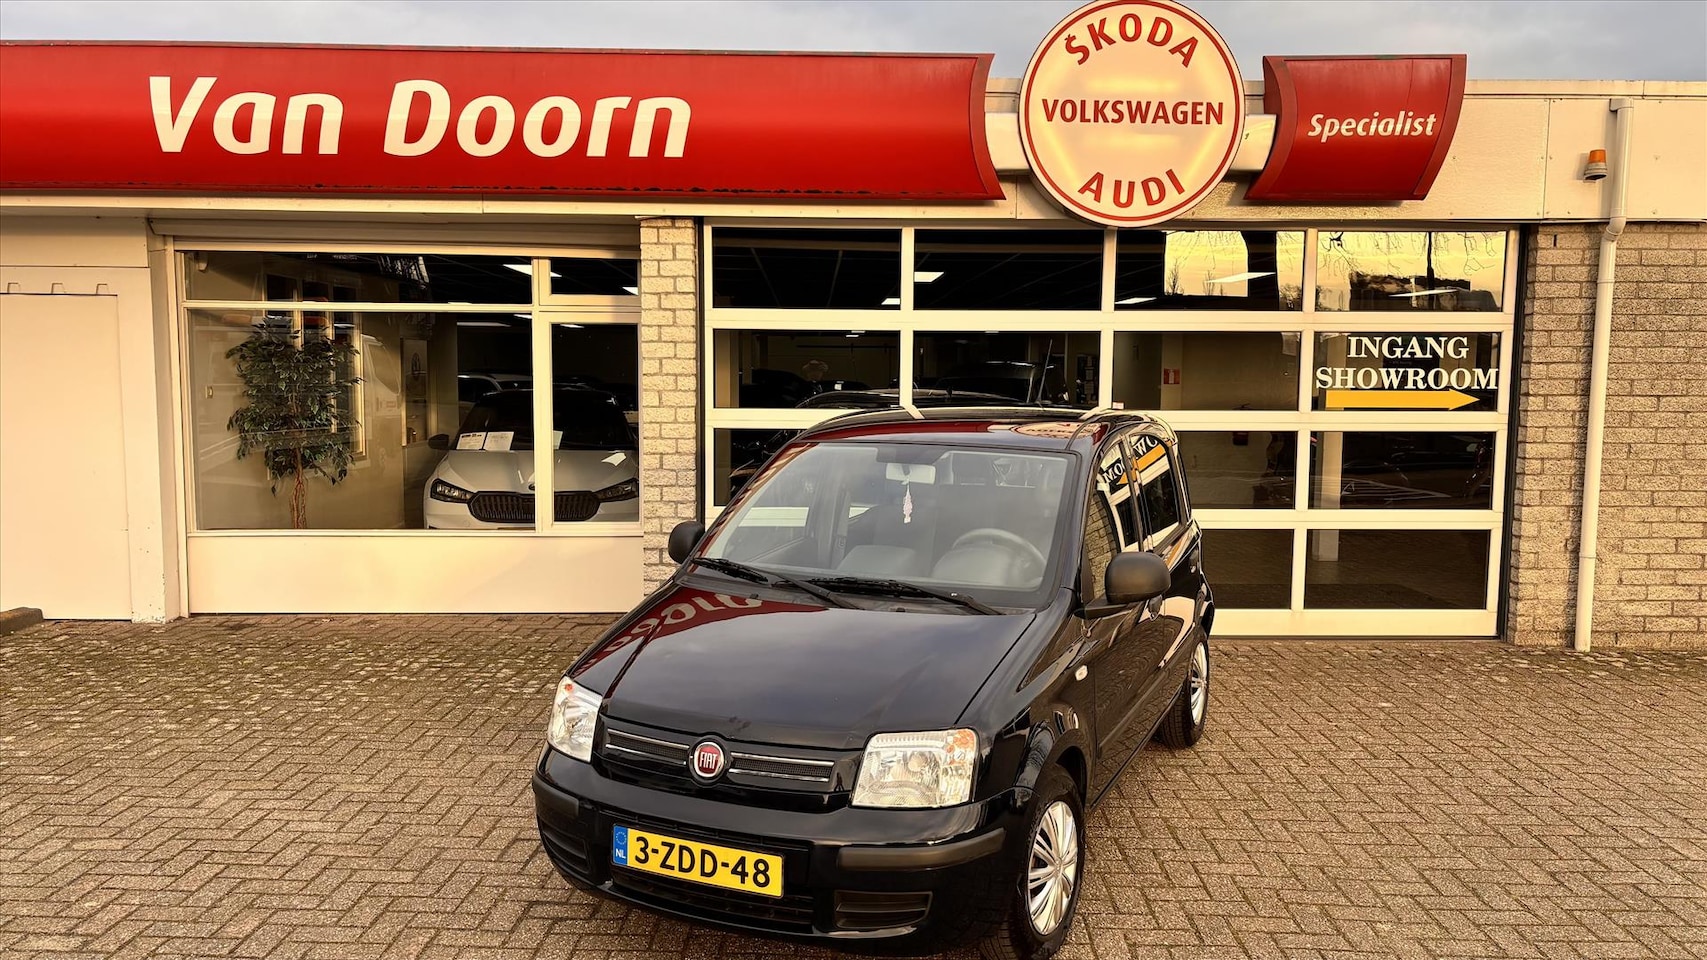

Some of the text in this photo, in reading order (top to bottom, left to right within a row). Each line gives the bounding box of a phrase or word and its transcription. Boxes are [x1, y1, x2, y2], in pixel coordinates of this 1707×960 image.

[1064, 13, 1199, 68] ŠKODA
[149, 75, 692, 158] Van Doorn
[1042, 98, 1223, 125] VOLKSWAGEN
[1307, 110, 1437, 143] Specialist
[1077, 168, 1186, 209] AUDI
[1347, 336, 1470, 359] INGANG
[1315, 367, 1499, 390] SHOWROOM
[700, 751, 718, 770] FIAT
[615, 848, 626, 860] NL
[634, 836, 771, 888] 3-ZDD-48
